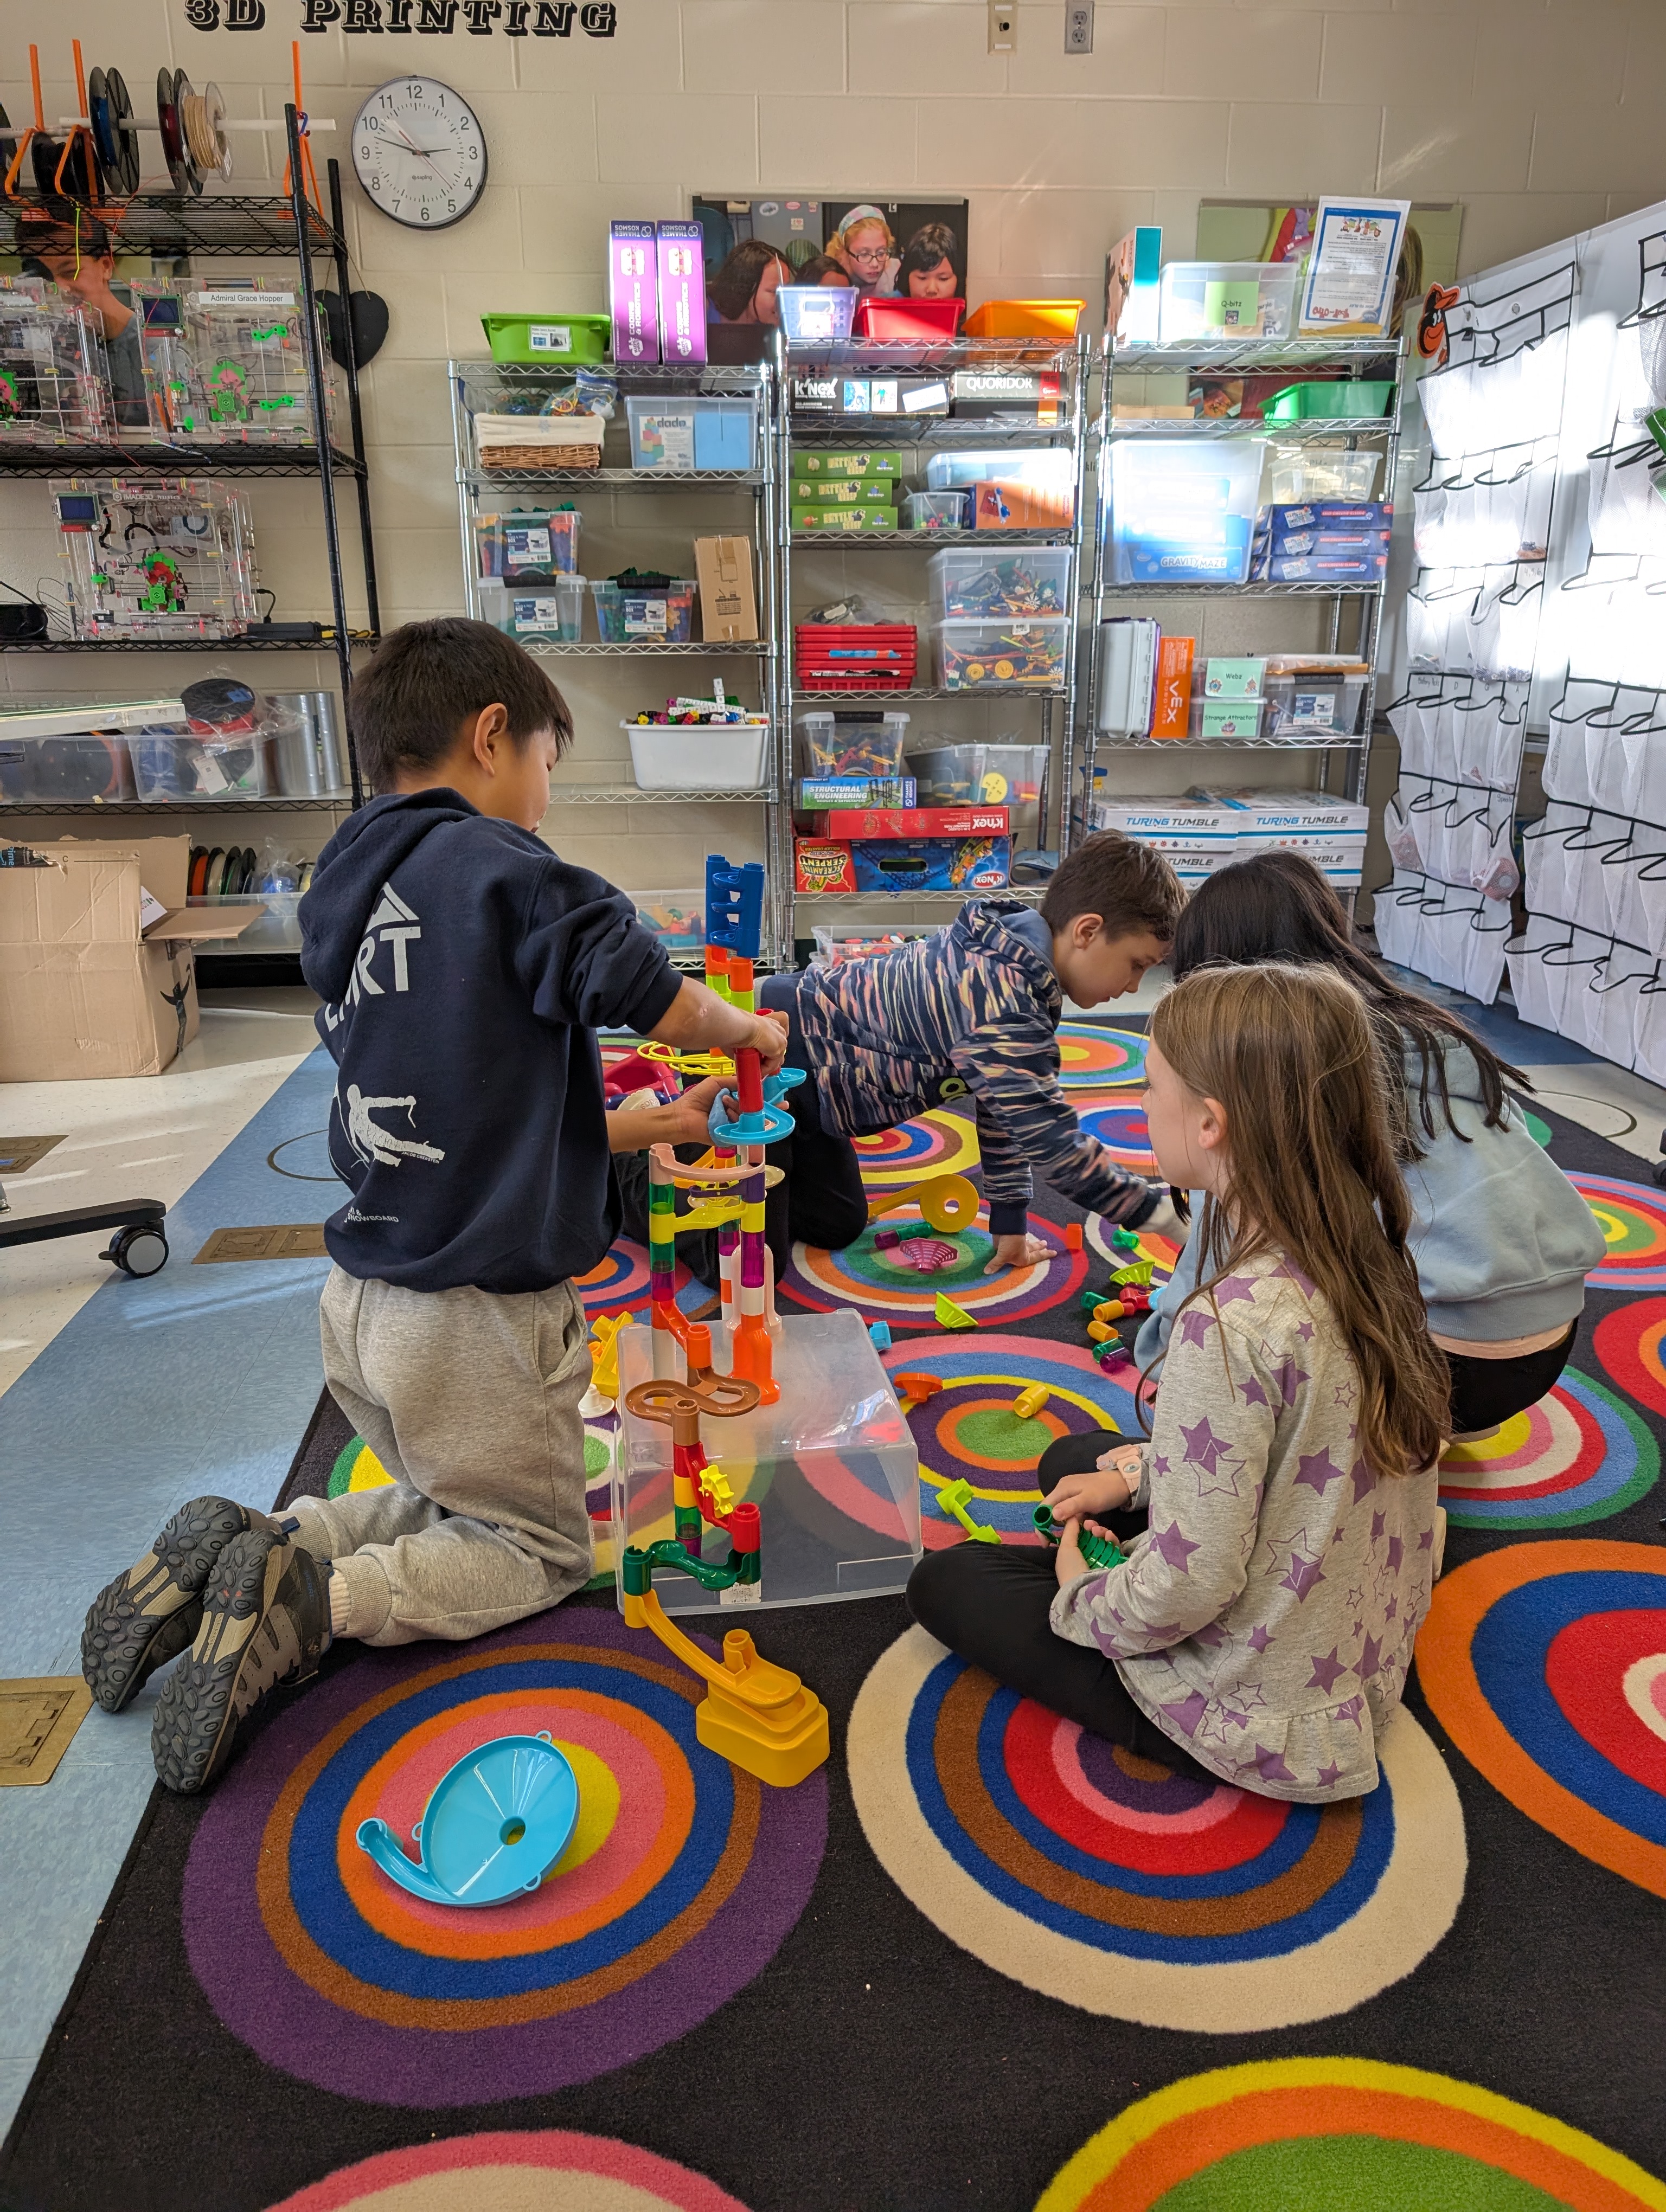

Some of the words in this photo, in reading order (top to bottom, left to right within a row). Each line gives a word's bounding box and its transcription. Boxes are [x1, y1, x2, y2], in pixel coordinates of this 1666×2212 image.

[183, 0, 265, 31] 3D
[300, 0, 617, 37] PRINTING
[406, 85, 422, 99] 12
[379, 95, 393, 108] 11
[439, 94, 444, 107] 1
[362, 116, 378, 130] 10
[460, 117, 469, 130] 2
[361, 146, 370, 160] 9
[469, 146, 478, 160] 3
[371, 177, 380, 190] 8
[464, 177, 473, 190] 4
[392, 200, 400, 213] 7
[447, 200, 456, 213] 5
[421, 207, 430, 221] 6
[966, 377, 1033, 391] QUORIDOR
[657, 417, 686, 427] dado
[1162, 557, 1200, 568] GRAVITY
[1200, 559, 1226, 568] MAZE
[1167, 680, 1183, 723] VEX
[1126, 818, 1169, 827] TURING
[1172, 818, 1219, 827] TUMBLE
[1256, 816, 1299, 826] TURING
[1302, 816, 1348, 824] TUMBLE
[801, 857, 844, 866] SERPENT
[1309, 855, 1344, 863] MBLE
[348, 1212, 399, 1223] SNOWBOARD
